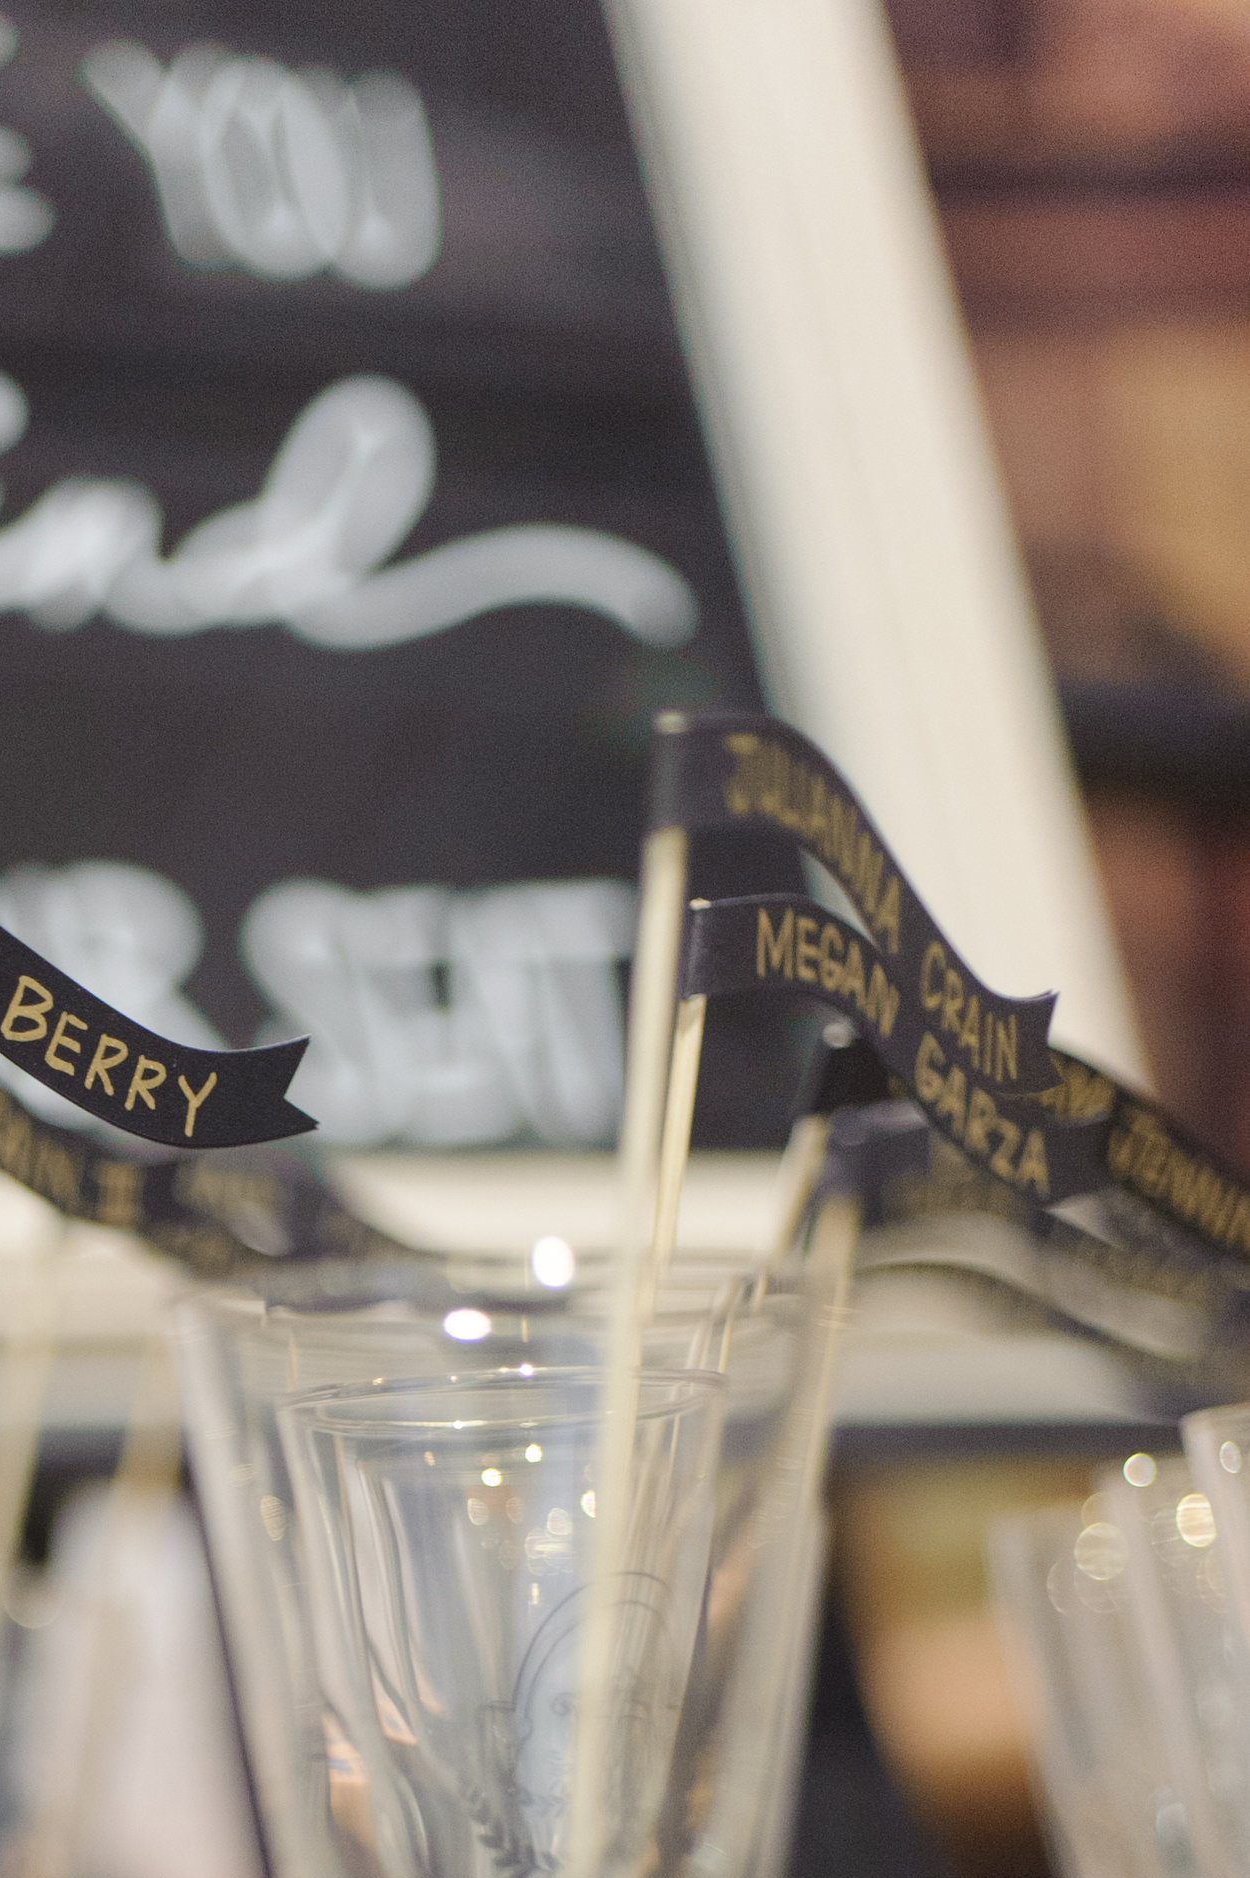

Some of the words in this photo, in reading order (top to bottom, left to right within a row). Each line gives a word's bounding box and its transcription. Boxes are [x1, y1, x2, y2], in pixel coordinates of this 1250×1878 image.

[1, 975, 217, 1137] BERRY
[756, 908, 900, 1038] MEGAN
[914, 1031, 1048, 1197] GARZA
[919, 941, 1018, 1083] CRAIN
